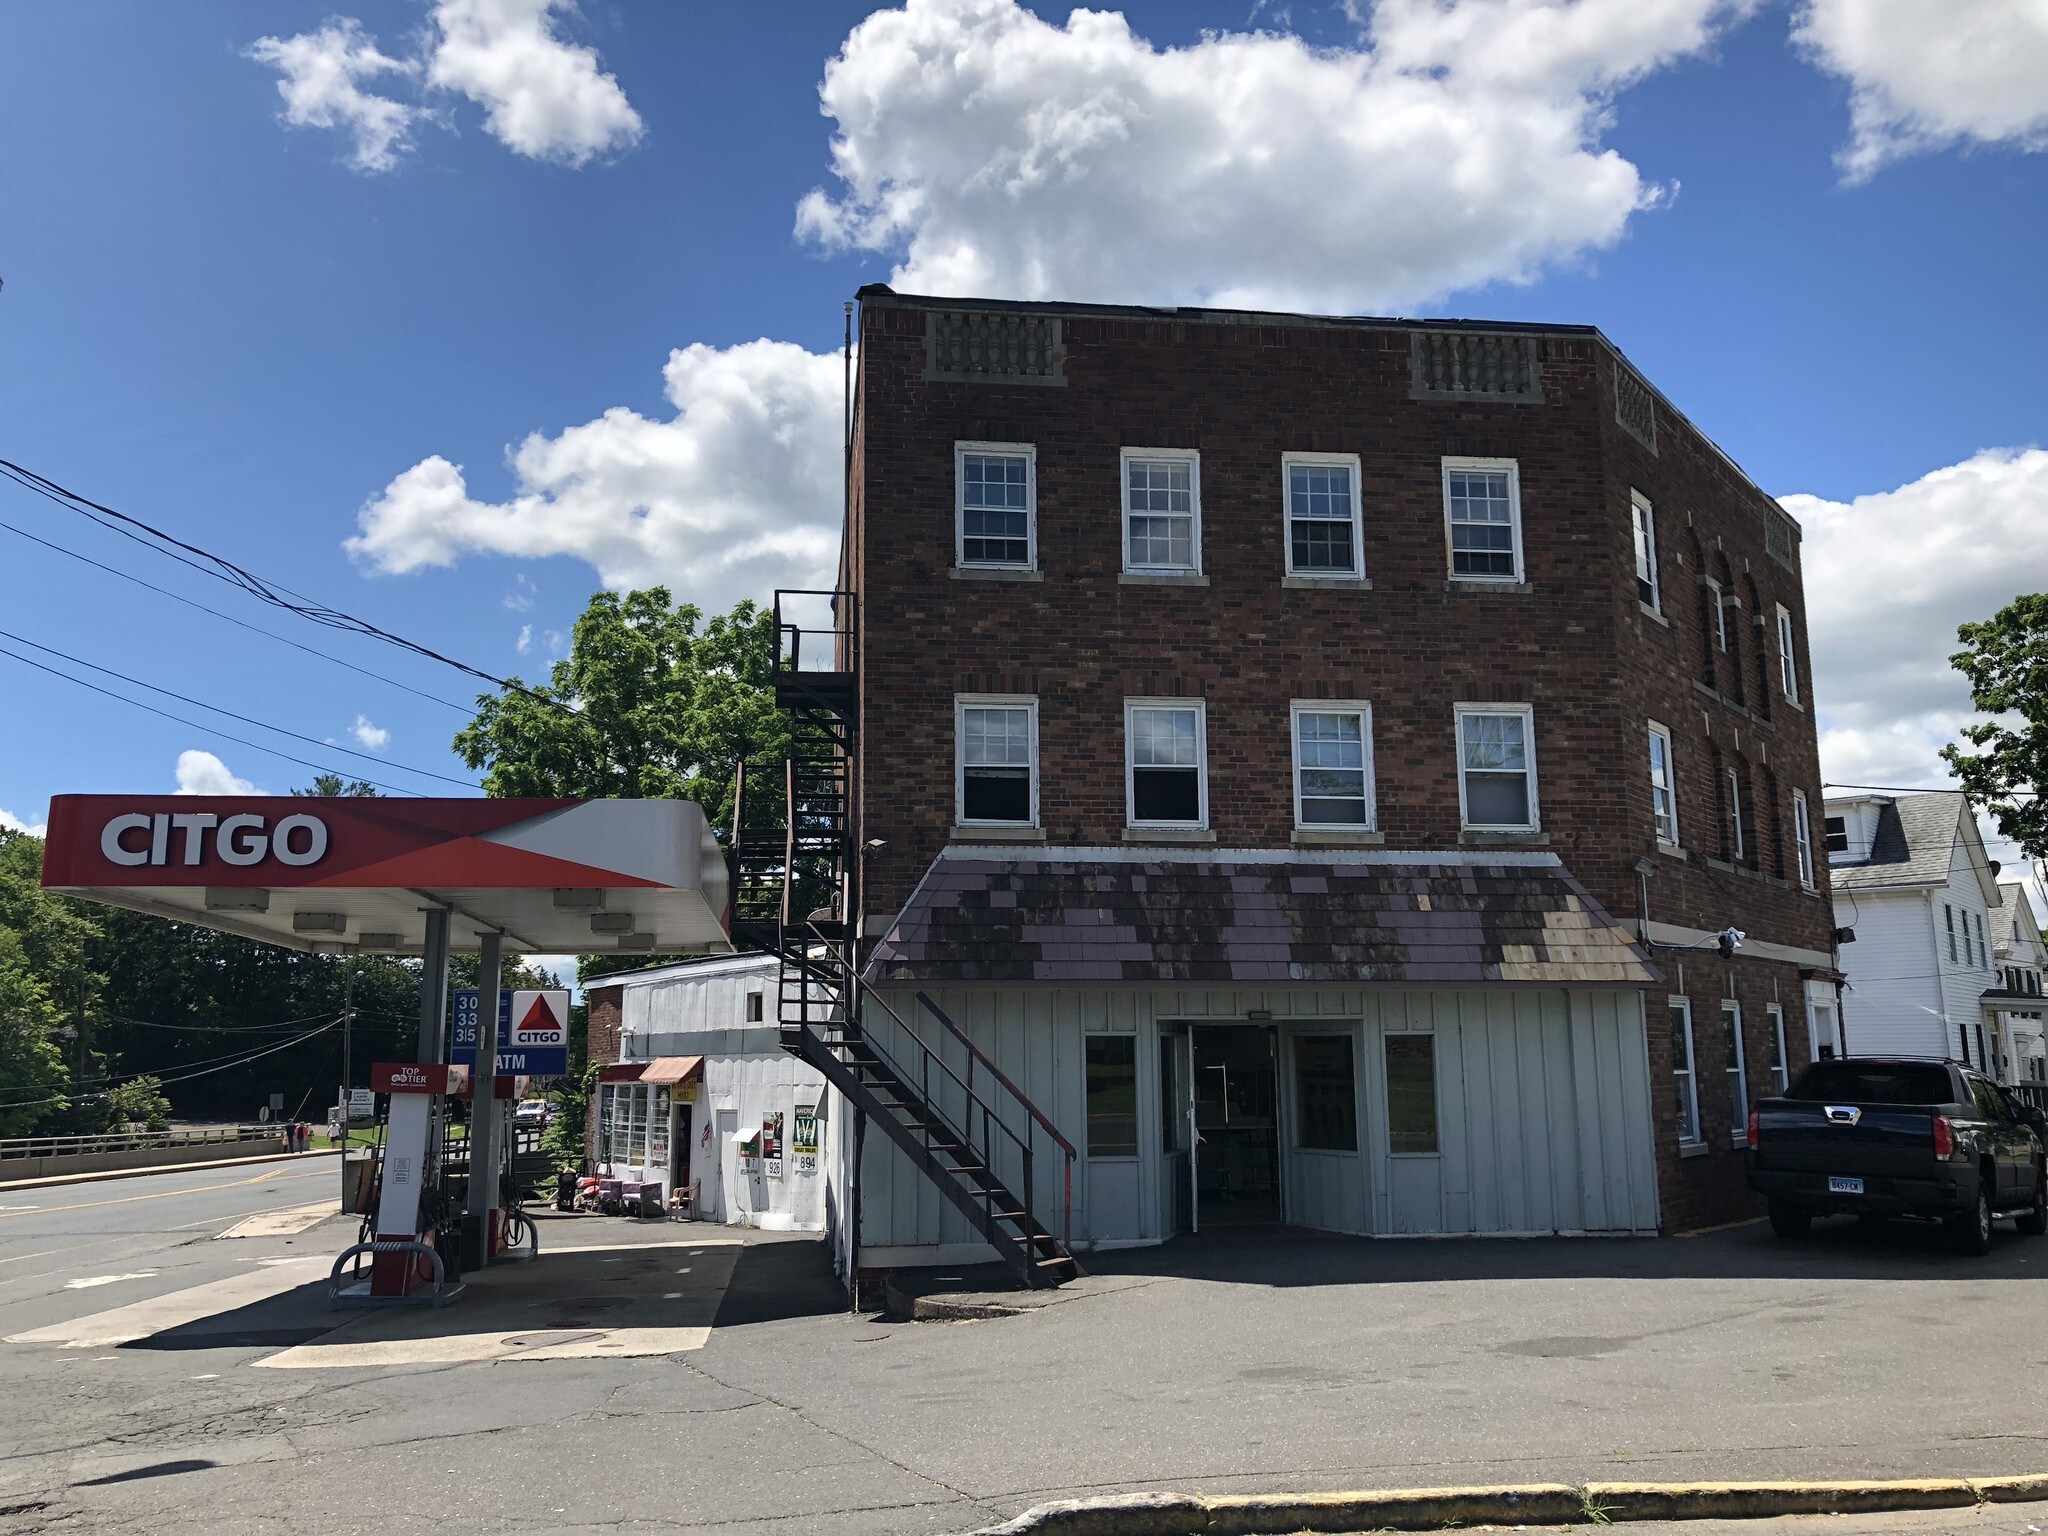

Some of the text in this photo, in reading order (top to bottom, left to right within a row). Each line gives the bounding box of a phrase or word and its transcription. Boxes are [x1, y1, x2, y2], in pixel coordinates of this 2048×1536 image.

[100, 812, 328, 866] CITGO
[517, 1031, 560, 1043] CITGO
[495, 1054, 526, 1070] ATM
[401, 1067, 420, 1076] TOP
[407, 1075, 427, 1084] TIER
[768, 1161, 781, 1175] 926
[800, 1156, 816, 1170] 894
